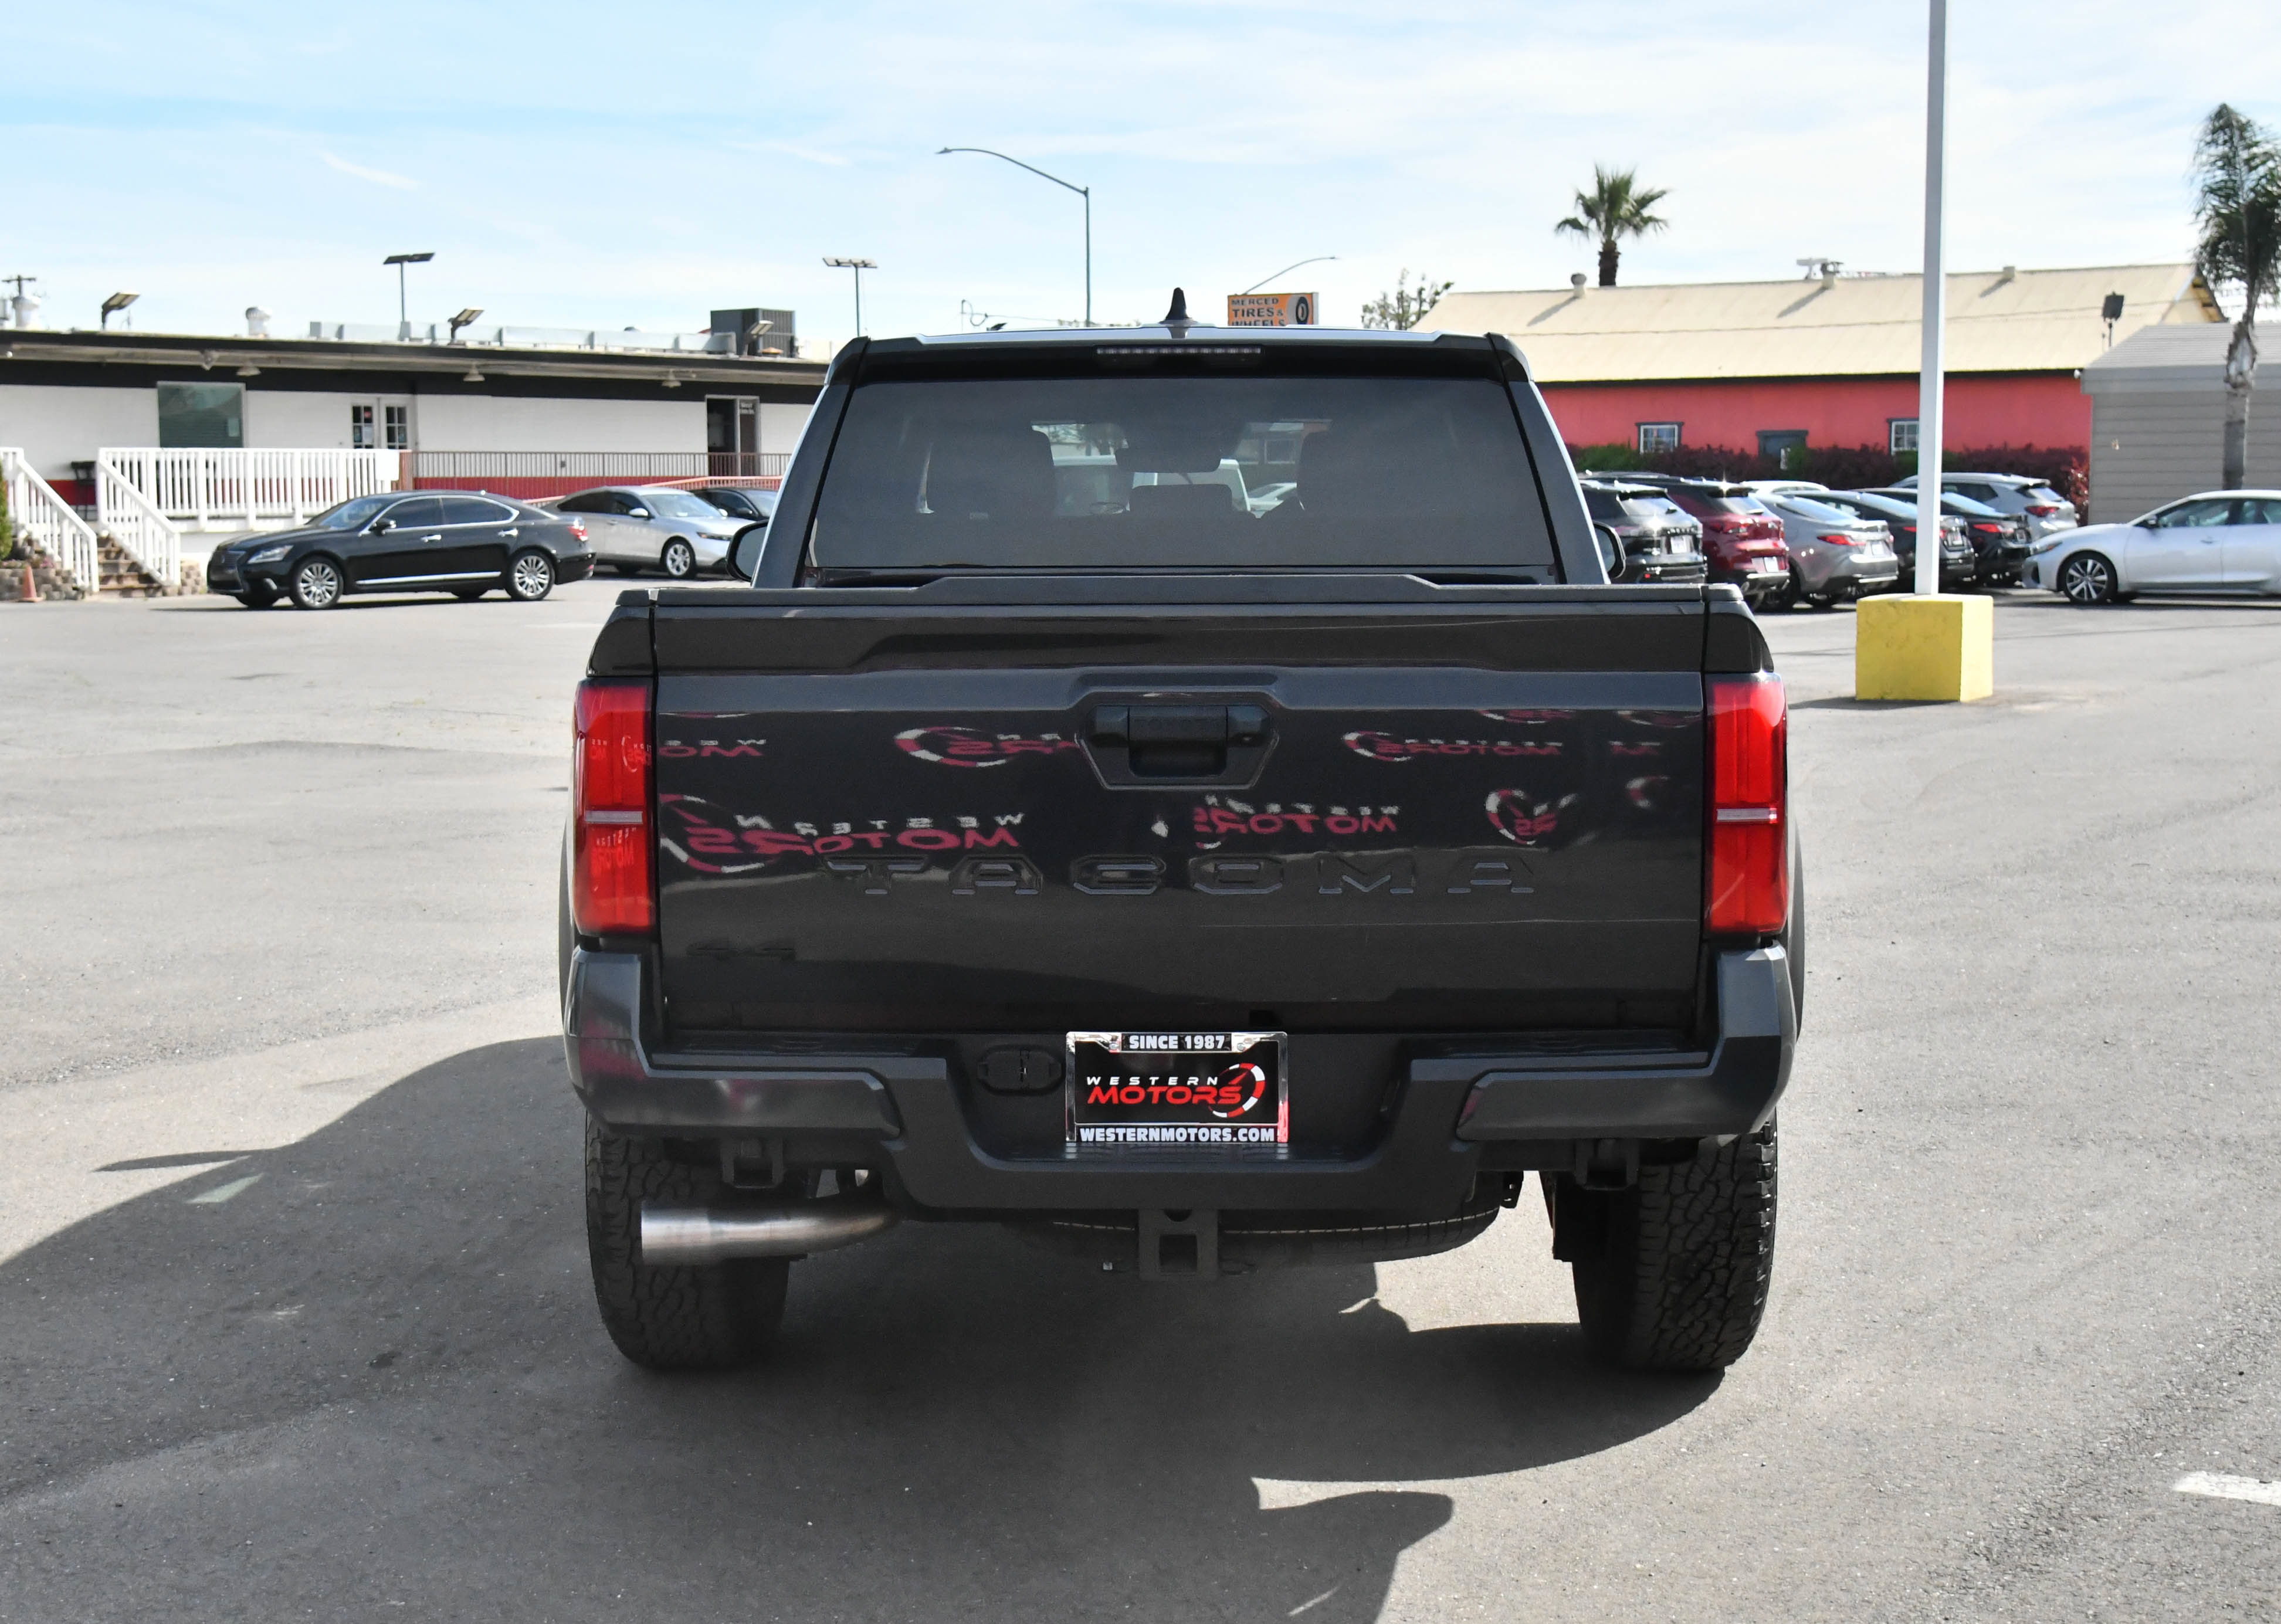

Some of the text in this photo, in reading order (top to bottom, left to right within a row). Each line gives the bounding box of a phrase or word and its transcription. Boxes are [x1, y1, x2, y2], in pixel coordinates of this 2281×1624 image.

[1232, 297, 1279, 306] MERCED
[1232, 308, 1274, 318] TIRES
[822, 854, 1534, 895] TACOMA
[1130, 1035, 1225, 1049] SINCE 1987
[1087, 1077, 1218, 1085] WESTERN
[1087, 1086, 1242, 1104] MOTORS
[1080, 1128, 1275, 1142] WESTERNMOTORS.COM
